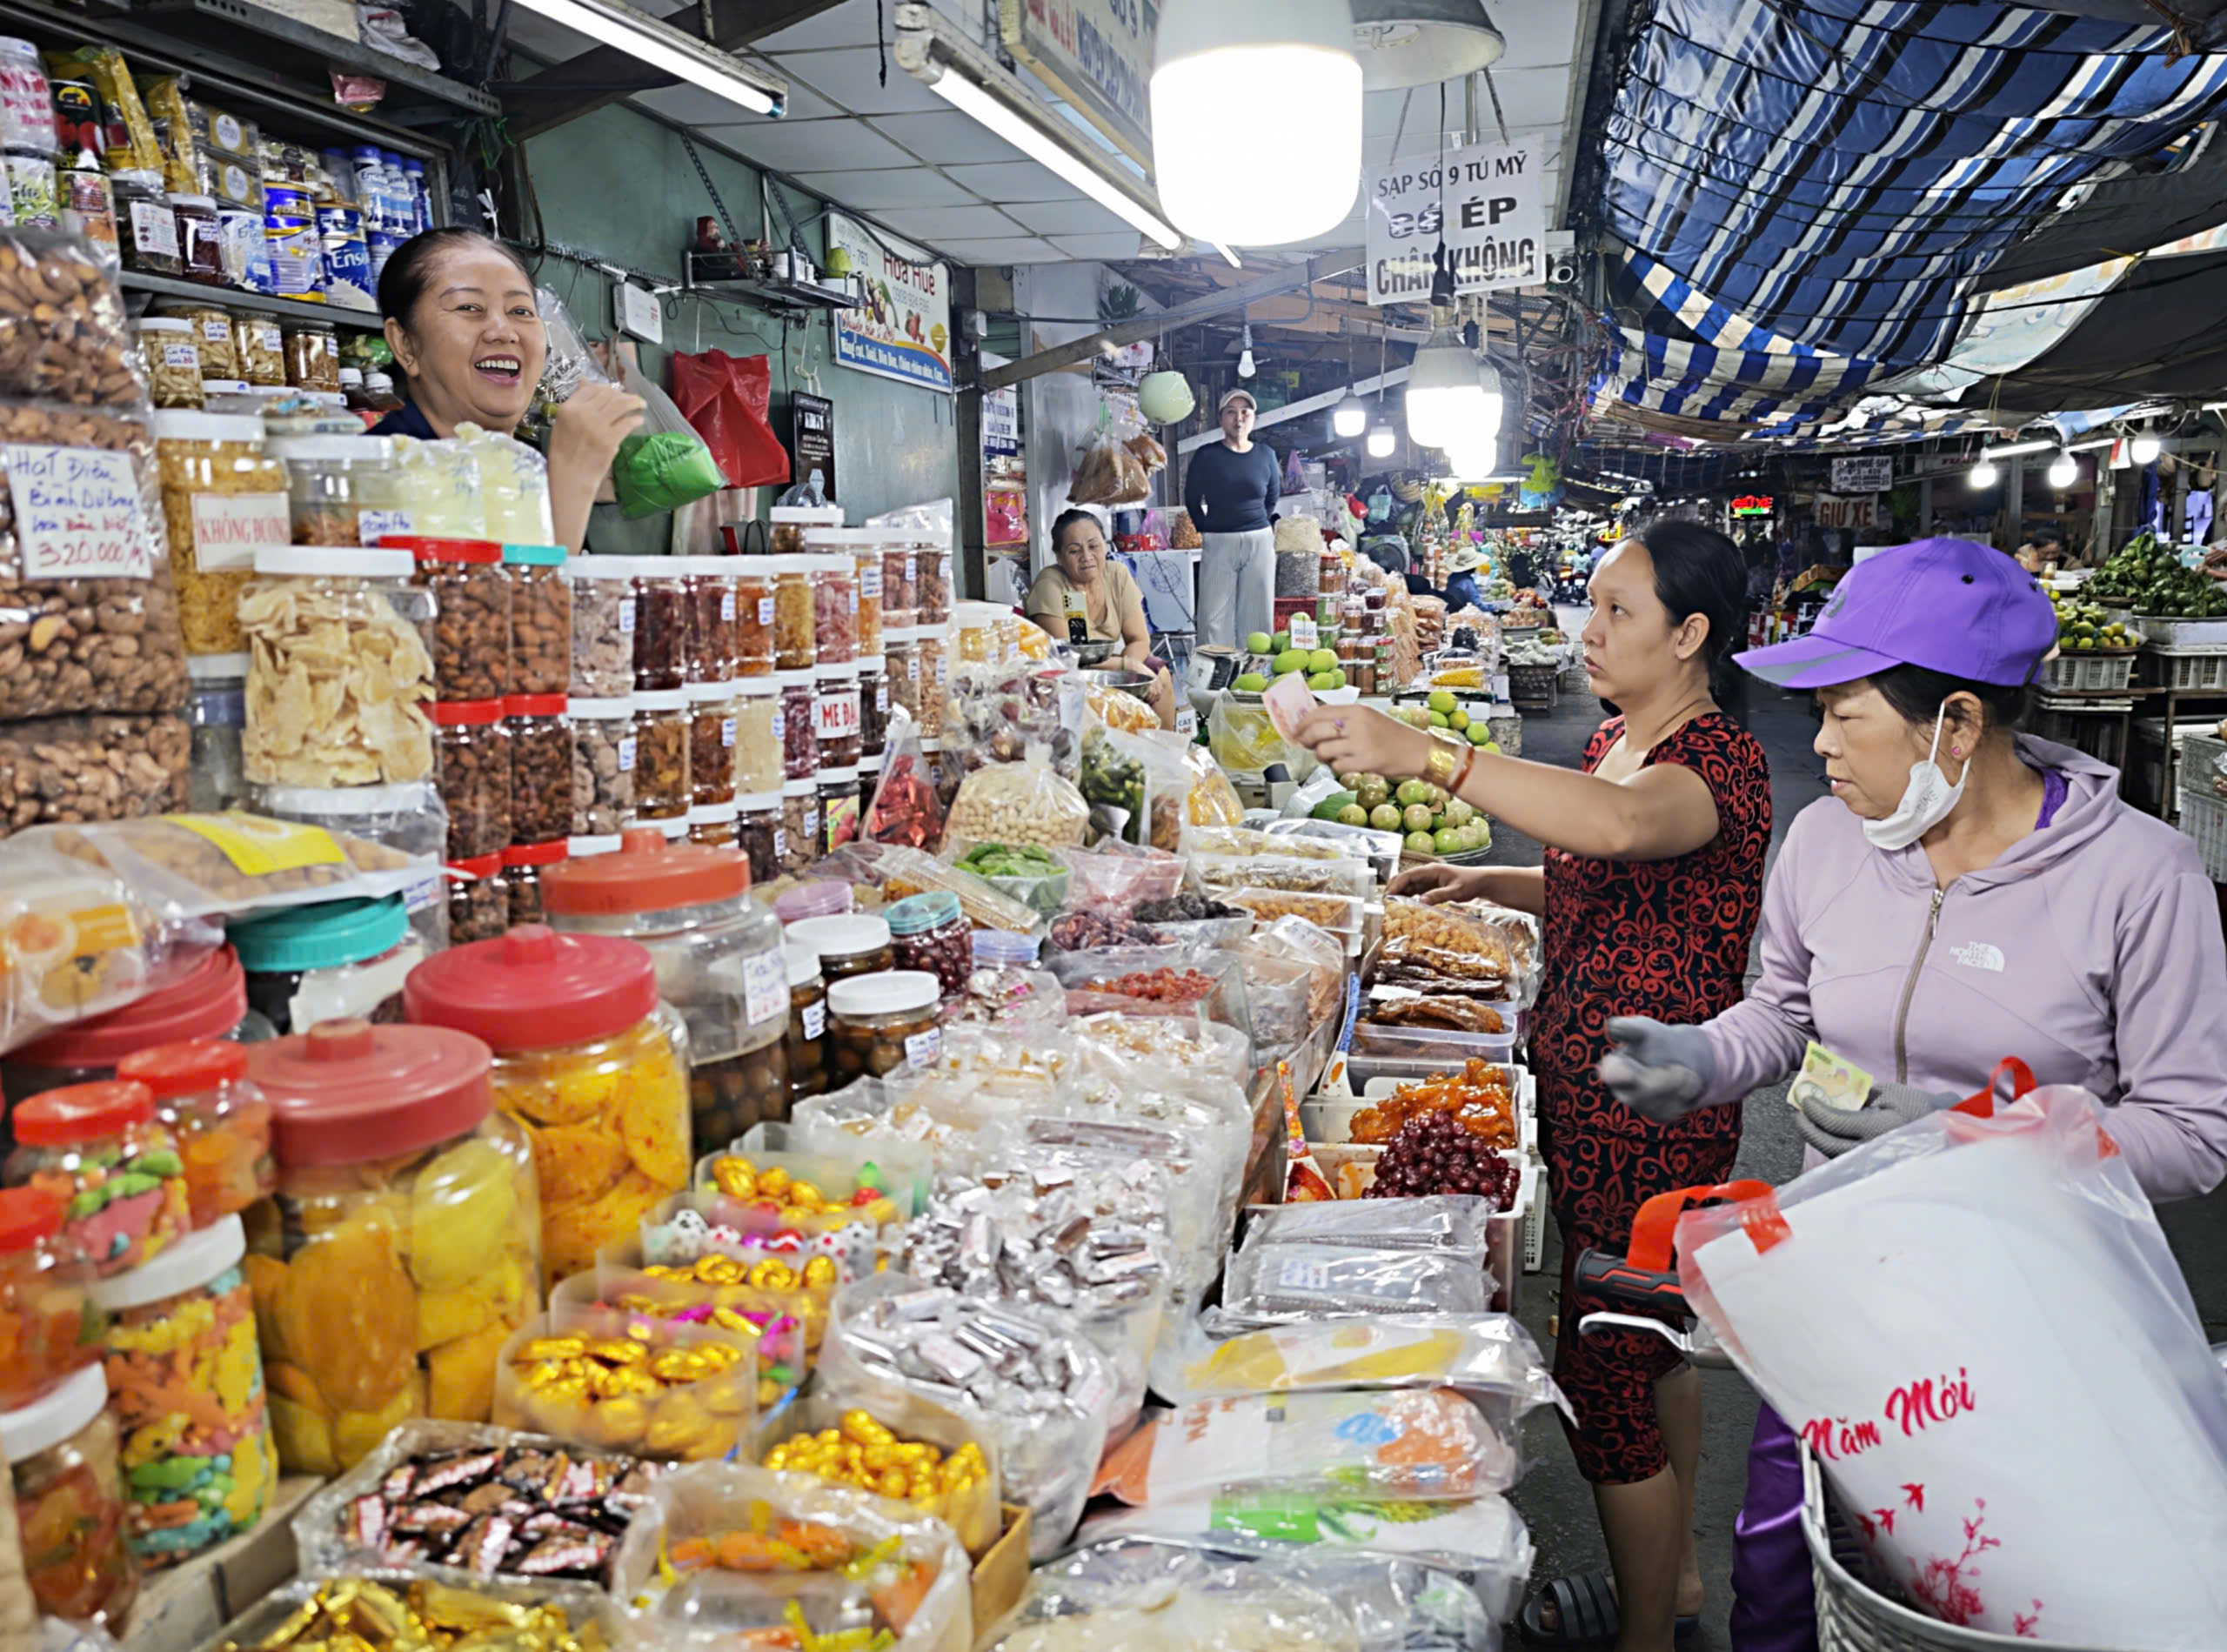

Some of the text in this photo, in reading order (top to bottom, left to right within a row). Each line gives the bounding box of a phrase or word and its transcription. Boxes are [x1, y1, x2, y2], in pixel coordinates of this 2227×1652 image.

[1379, 175, 1413, 199] SẠP
[1448, 166, 1459, 185] 9
[1465, 156, 1488, 182] TÚ
[1495, 150, 1528, 177] MỸ
[1461, 197, 1517, 229] ÉP
[1448, 236, 1535, 284] KHÔNG
[1852, 500, 1873, 527] XE
[821, 703, 840, 728] ME
[1801, 1367, 1975, 1461] Năm Mới
